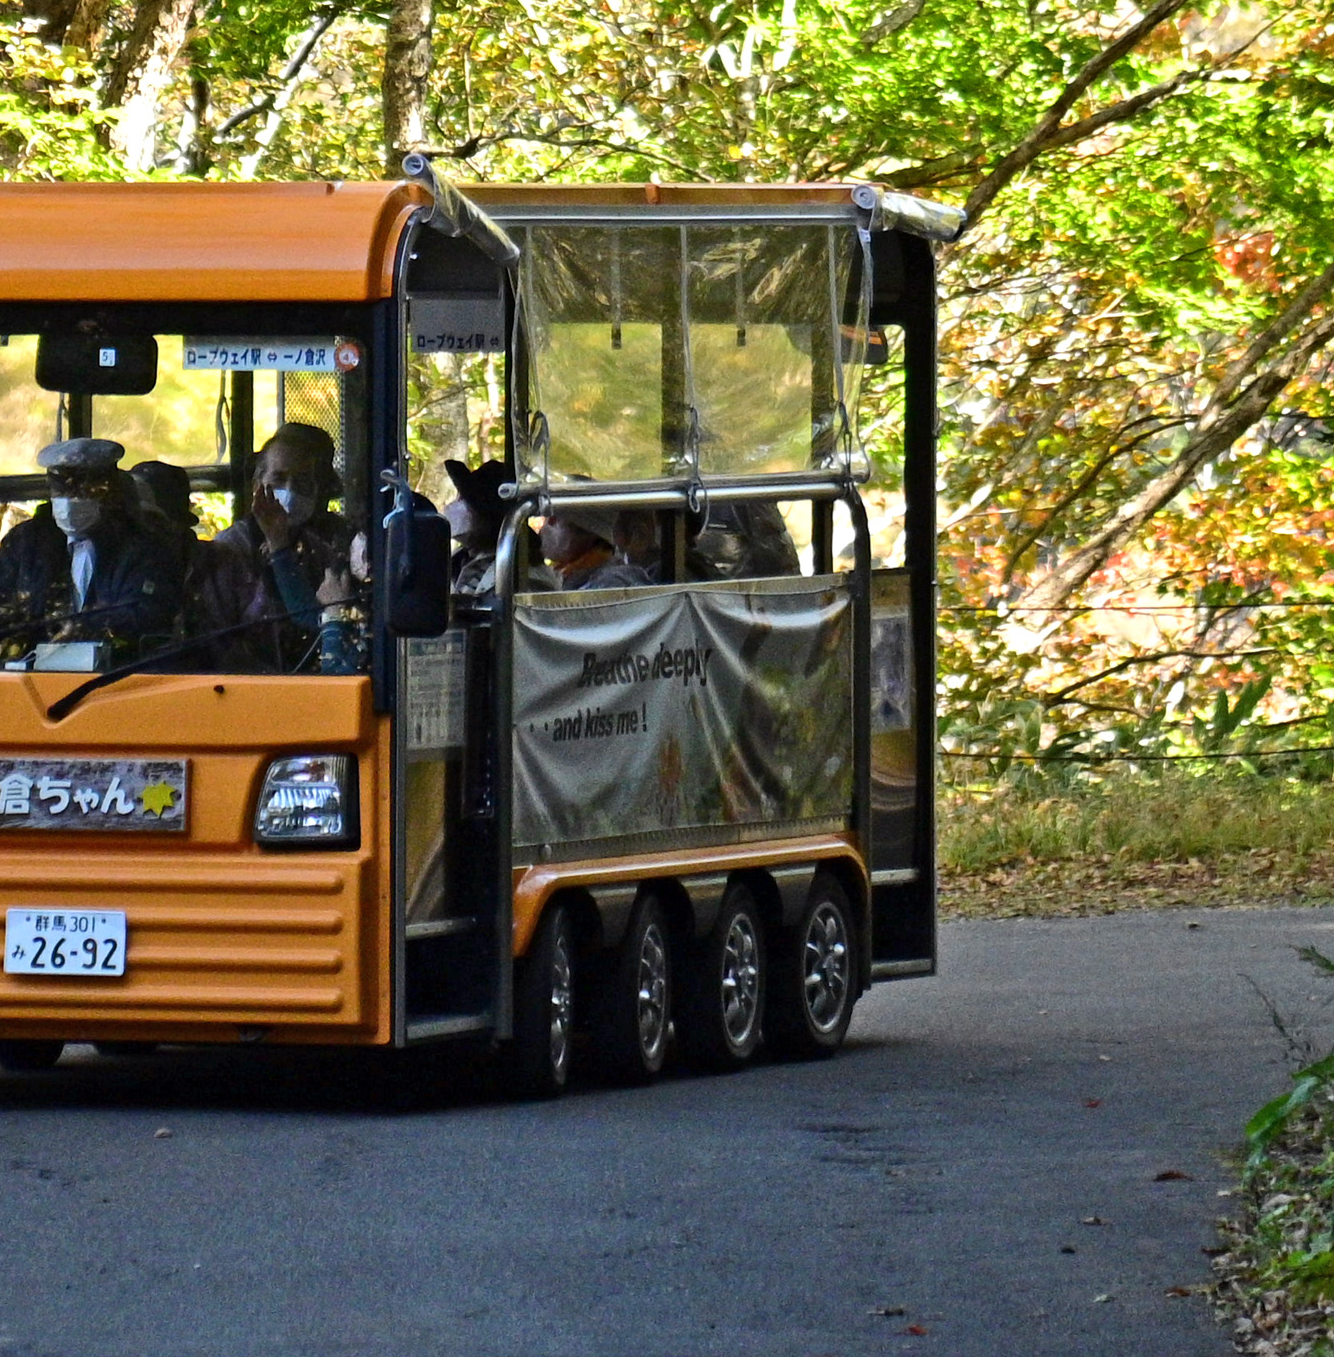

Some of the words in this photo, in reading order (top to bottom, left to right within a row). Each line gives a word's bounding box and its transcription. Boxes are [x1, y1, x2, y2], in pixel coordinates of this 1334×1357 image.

[187, 348, 261, 365] ロープウェイ駅
[284, 348, 326, 365] 一ノ倉沢
[652, 638, 713, 687] deeply
[553, 707, 582, 741] and
[585, 707, 613, 737] kiss
[30, 936, 118, 970] 26-92
